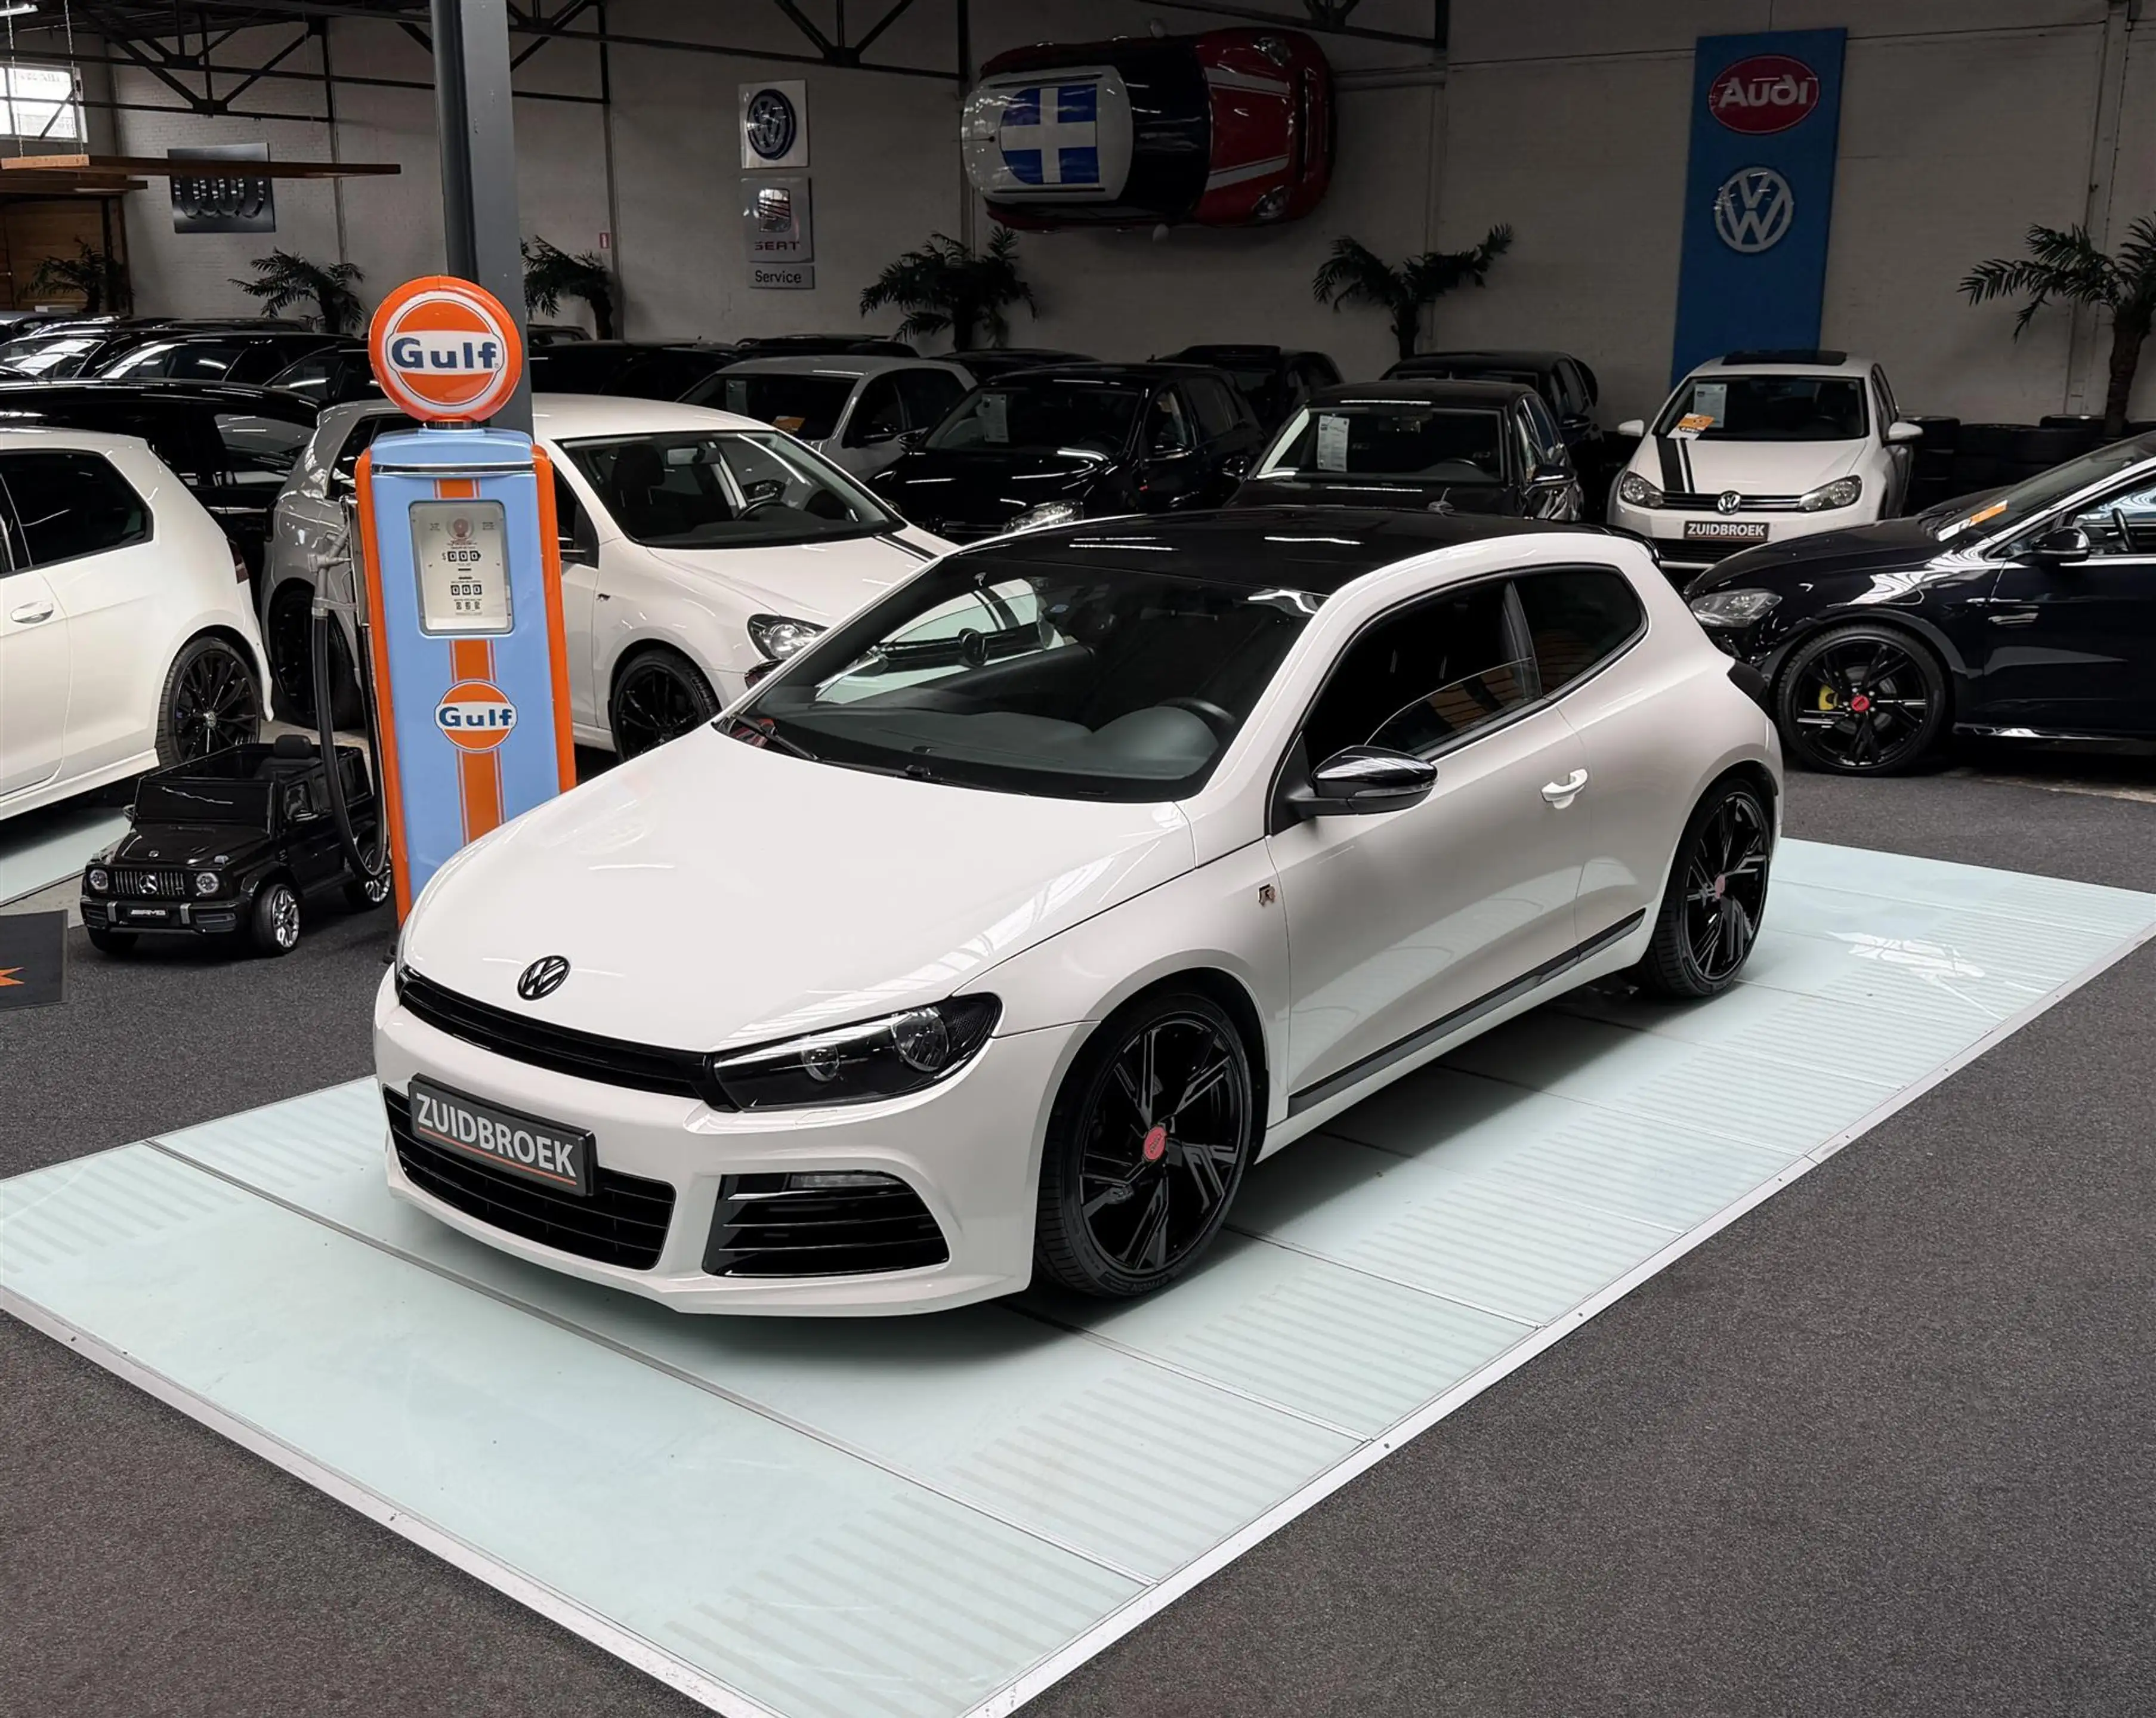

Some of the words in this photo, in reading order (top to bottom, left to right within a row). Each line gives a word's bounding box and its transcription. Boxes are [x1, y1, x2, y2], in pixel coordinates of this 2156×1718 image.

[1718, 75, 1809, 109] Audi
[754, 241, 800, 251] SEAT
[755, 270, 802, 284] Service
[391, 337, 497, 369] Gulf
[1687, 523, 1765, 536] ZUIDBROEK
[438, 706, 512, 727] Gulf
[416, 1093, 576, 1178] ZUIDBROEK
